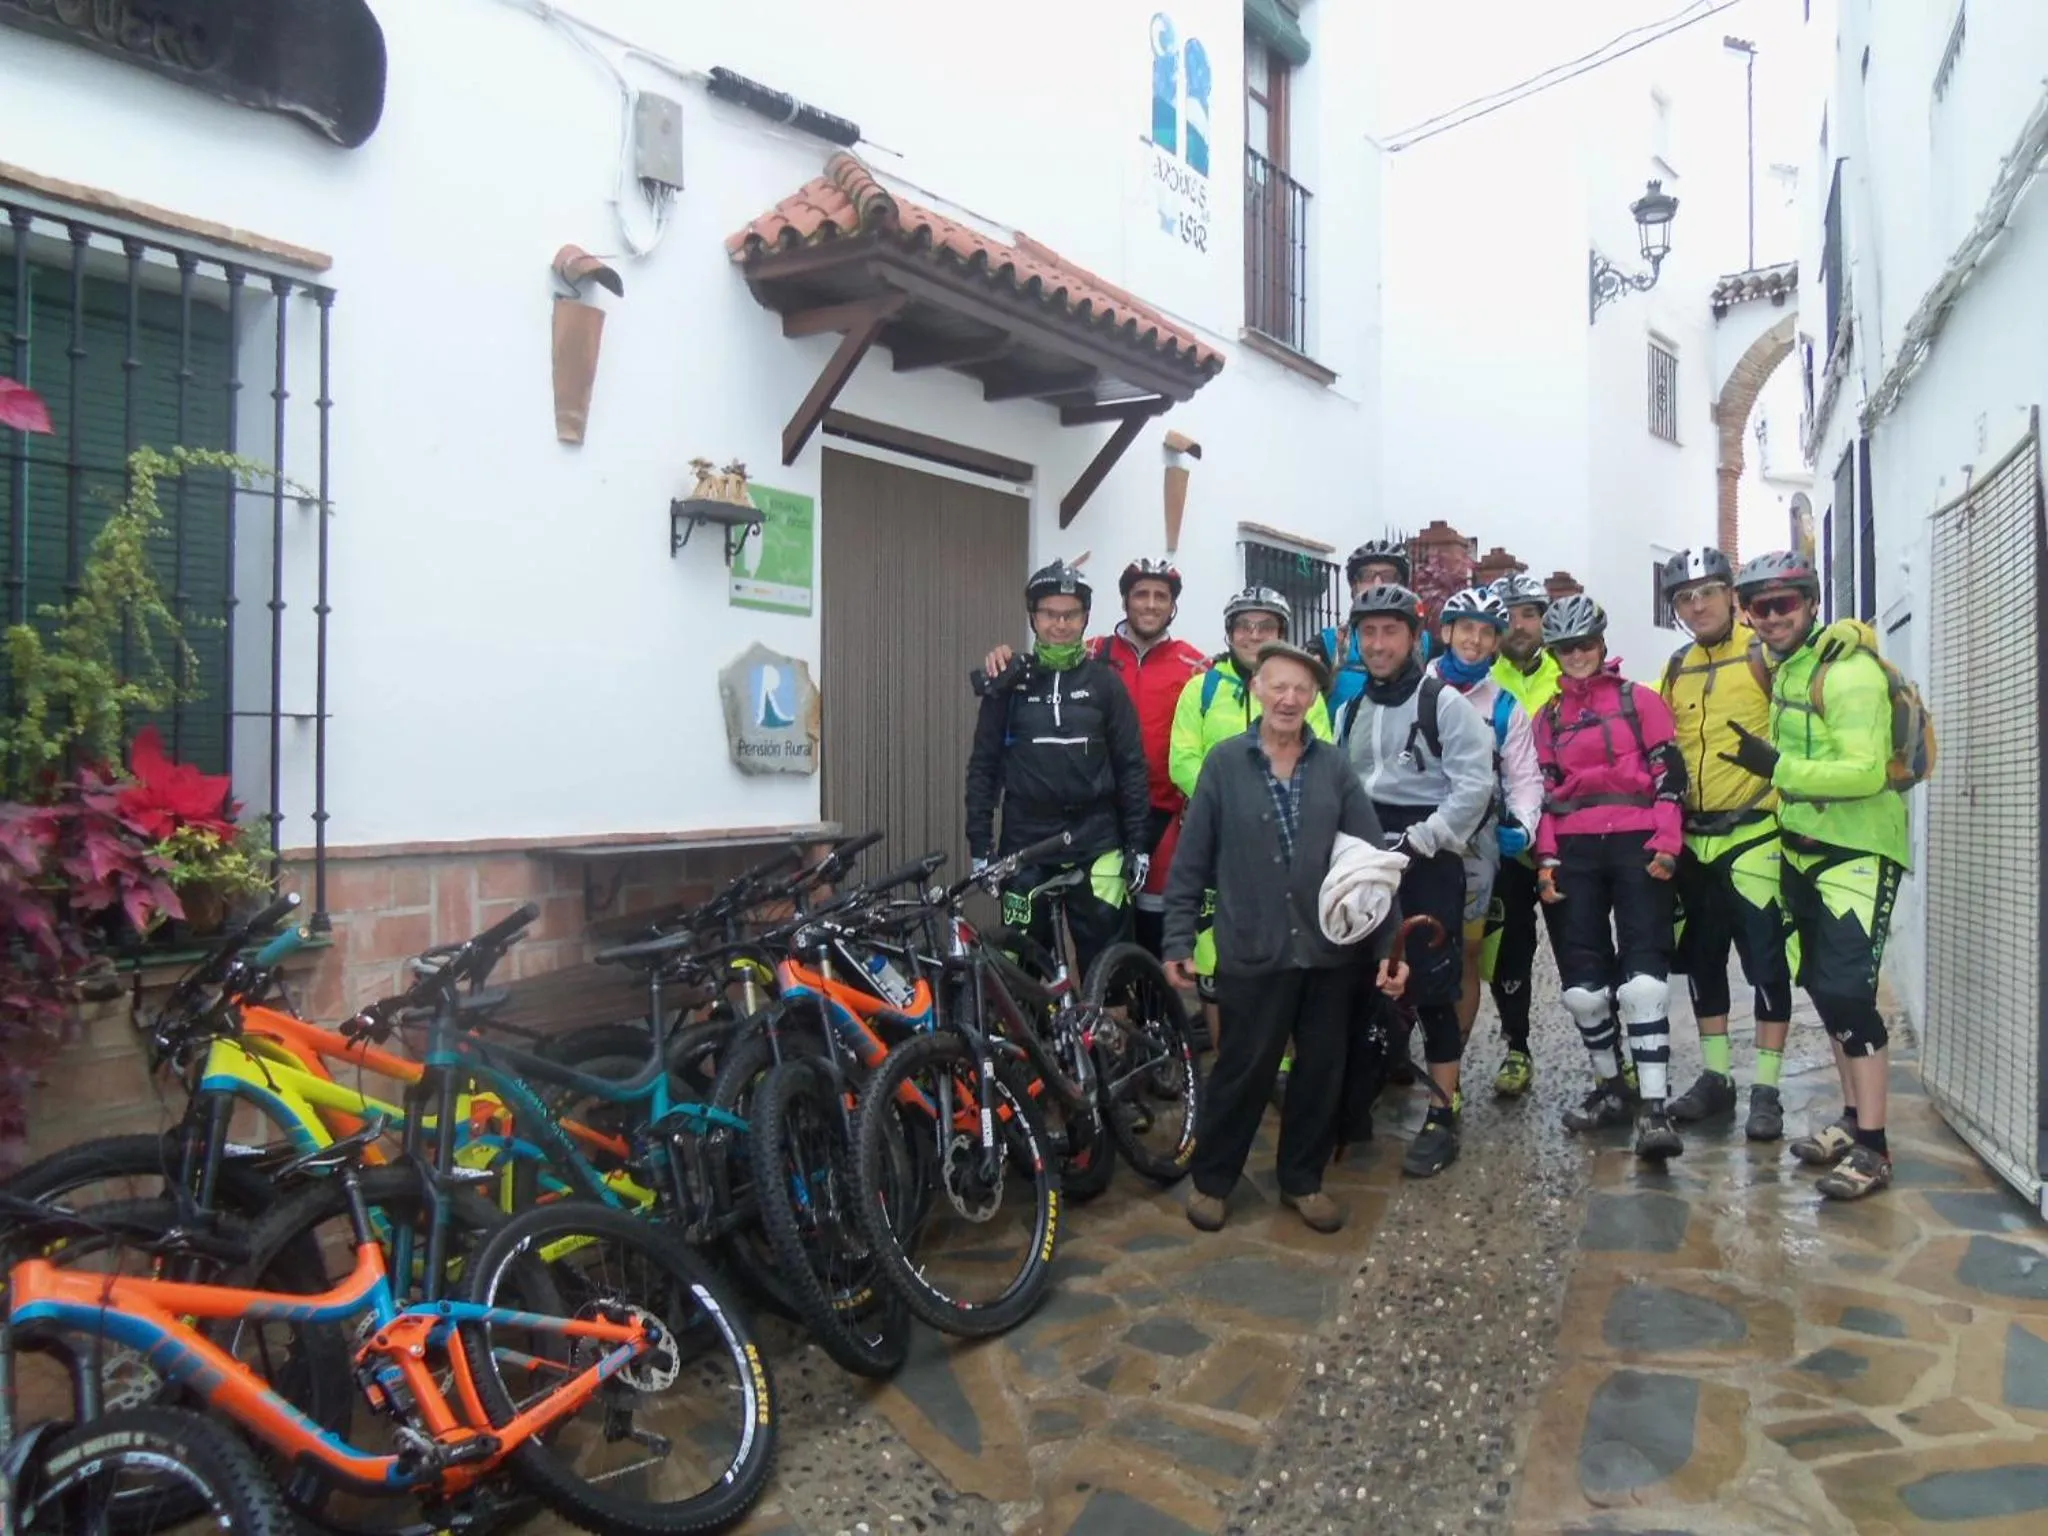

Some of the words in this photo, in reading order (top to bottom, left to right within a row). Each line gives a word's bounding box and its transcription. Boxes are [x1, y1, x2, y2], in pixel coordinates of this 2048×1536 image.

[736, 738, 781, 757] Pensión
[785, 740, 813, 757] Rural
[1041, 1190, 1058, 1262] MAXXIS
[745, 1343, 770, 1425] MAXXIS
